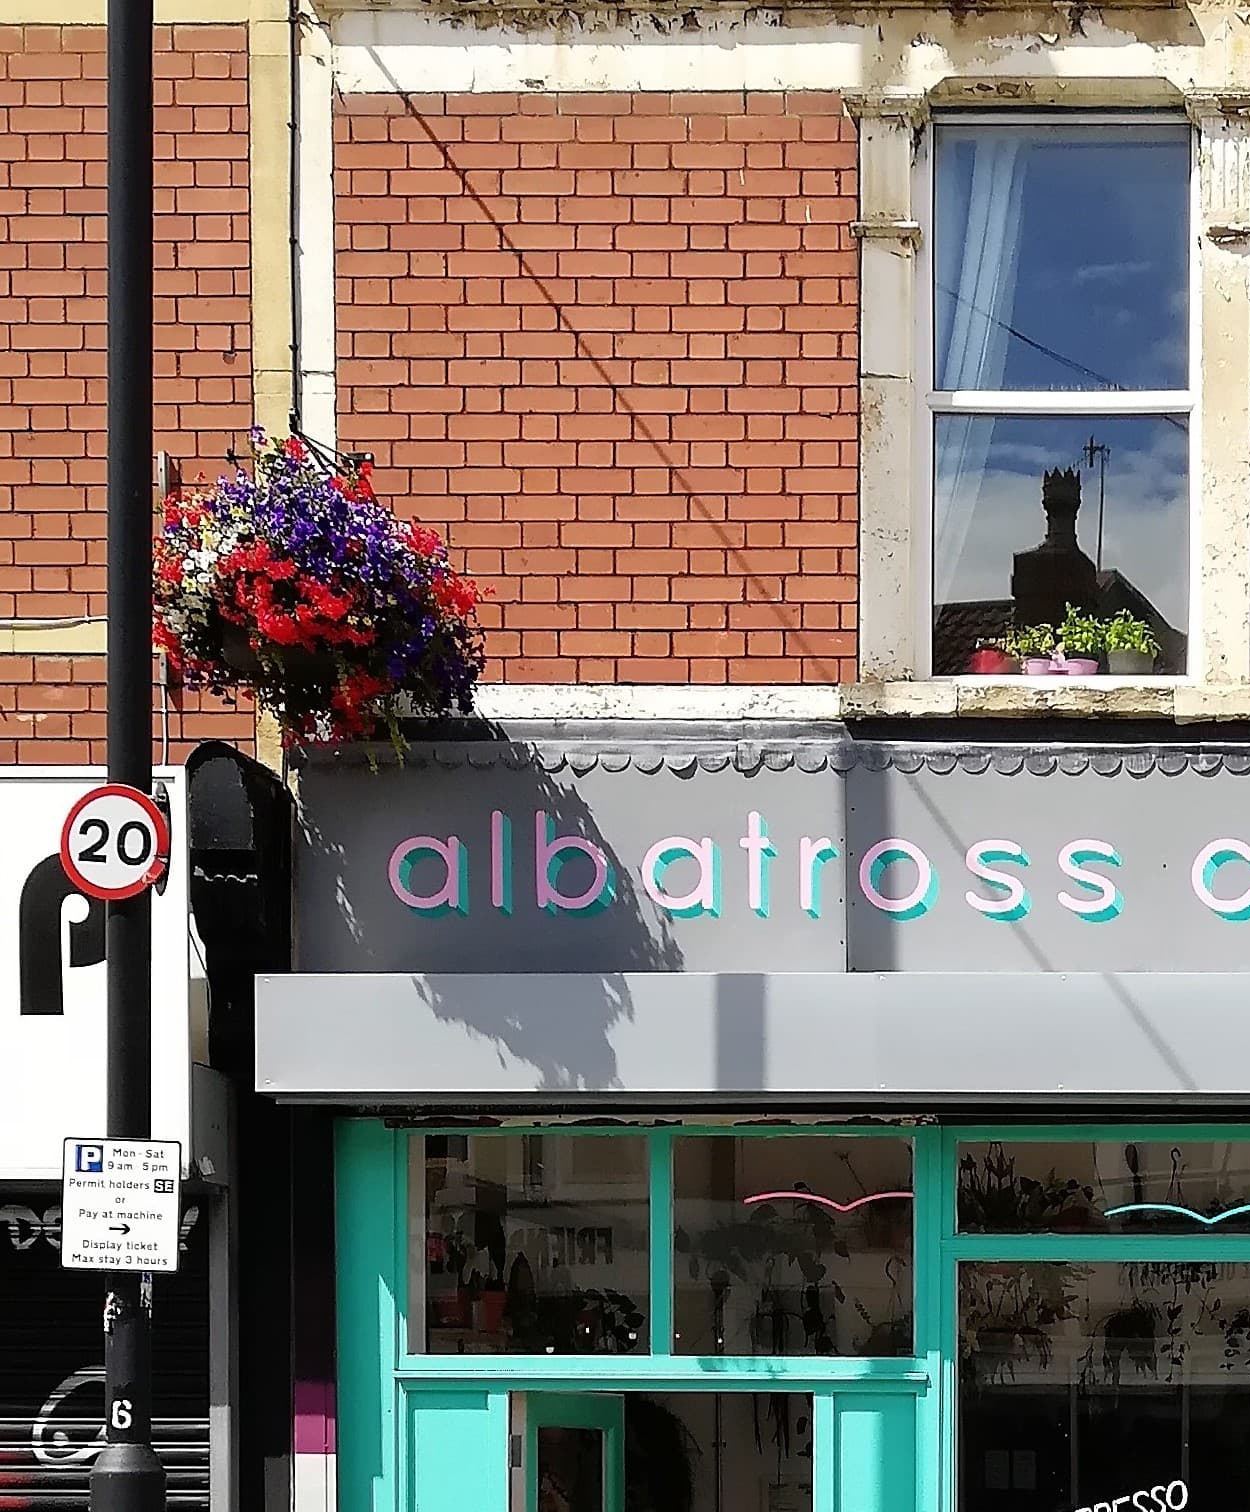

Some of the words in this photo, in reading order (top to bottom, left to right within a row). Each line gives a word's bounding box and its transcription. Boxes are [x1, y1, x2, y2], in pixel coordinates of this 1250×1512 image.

[77, 819, 152, 866] 20
[388, 809, 1124, 922] albatross
[112, 1148, 136, 1158] Mon
[145, 1149, 165, 1159] Sat
[69, 1178, 105, 1189] Permit
[109, 1180, 150, 1190] holders
[155, 1180, 173, 1192] SE
[115, 1196, 126, 1204] or
[78, 1208, 98, 1219] Pay
[101, 1210, 113, 1219] at
[116, 1210, 163, 1220] machine
[82, 1239, 122, 1251] Display
[126, 1241, 158, 1251] ticket
[71, 1253, 94, 1263] Max
[98, 1254, 121, 1265] stay
[125, 1255, 132, 1264] 3
[136, 1256, 168, 1266] hours
[111, 1400, 132, 1429] 6
